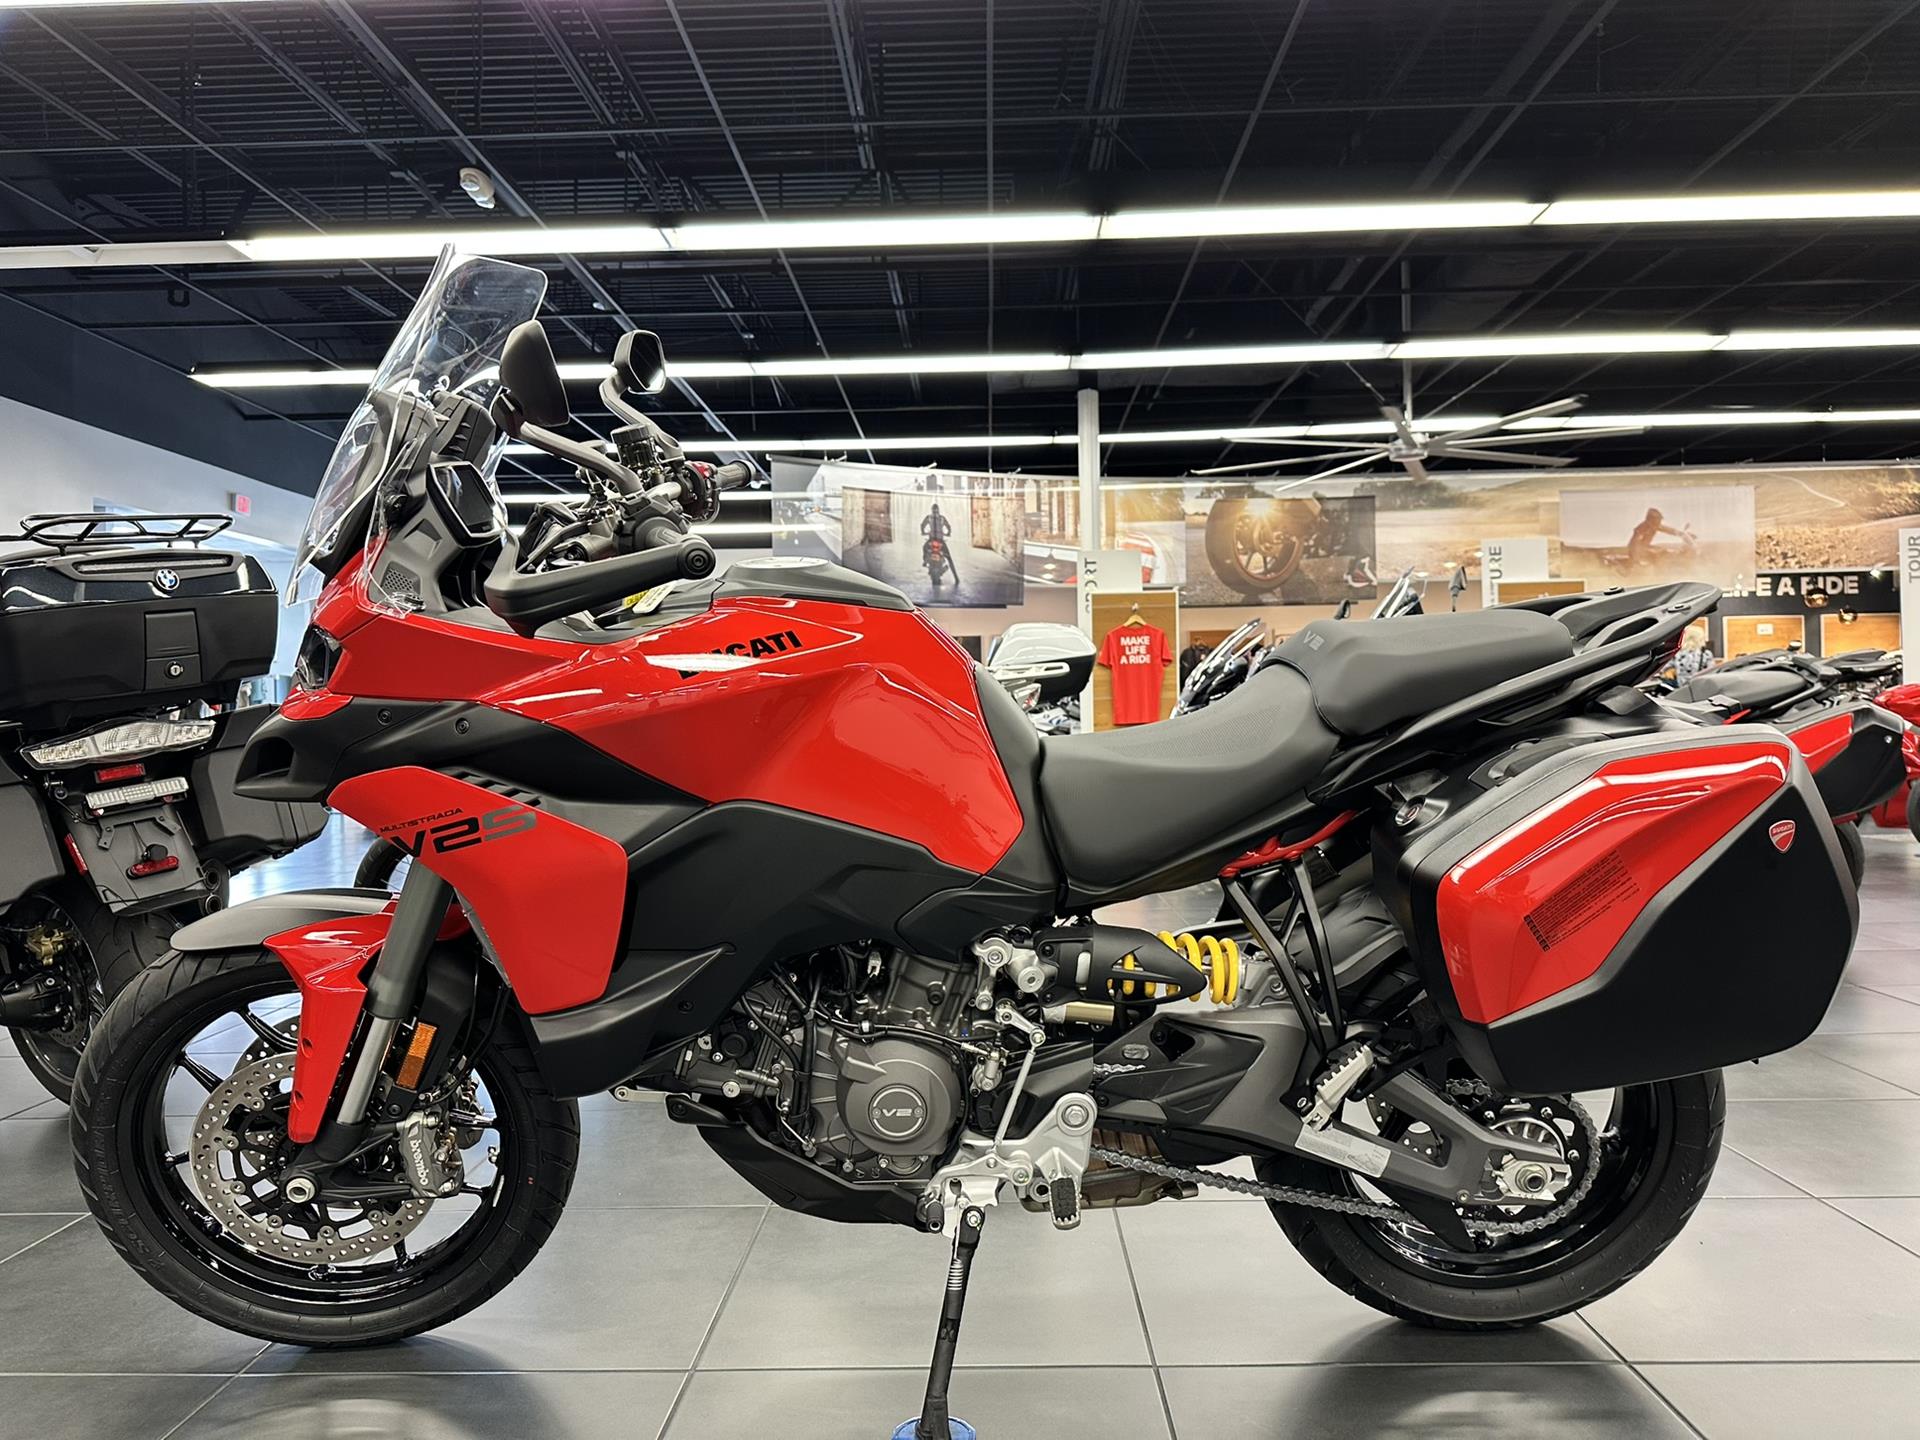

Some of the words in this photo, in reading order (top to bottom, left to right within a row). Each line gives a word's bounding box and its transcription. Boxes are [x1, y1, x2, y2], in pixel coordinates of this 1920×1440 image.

[1907, 535, 1920, 584] TOUR
[1776, 577, 1796, 597] A
[1120, 636, 1150, 647] MAKE
[1125, 646, 1147, 655] LIFE
[1120, 655, 1128, 664] A
[1129, 654, 1151, 664] RIDE
[379, 807, 464, 834] MULTISTRADA
[390, 804, 537, 858] V2S
[882, 1108, 912, 1117] V2
[409, 1139, 429, 1186] brembo
